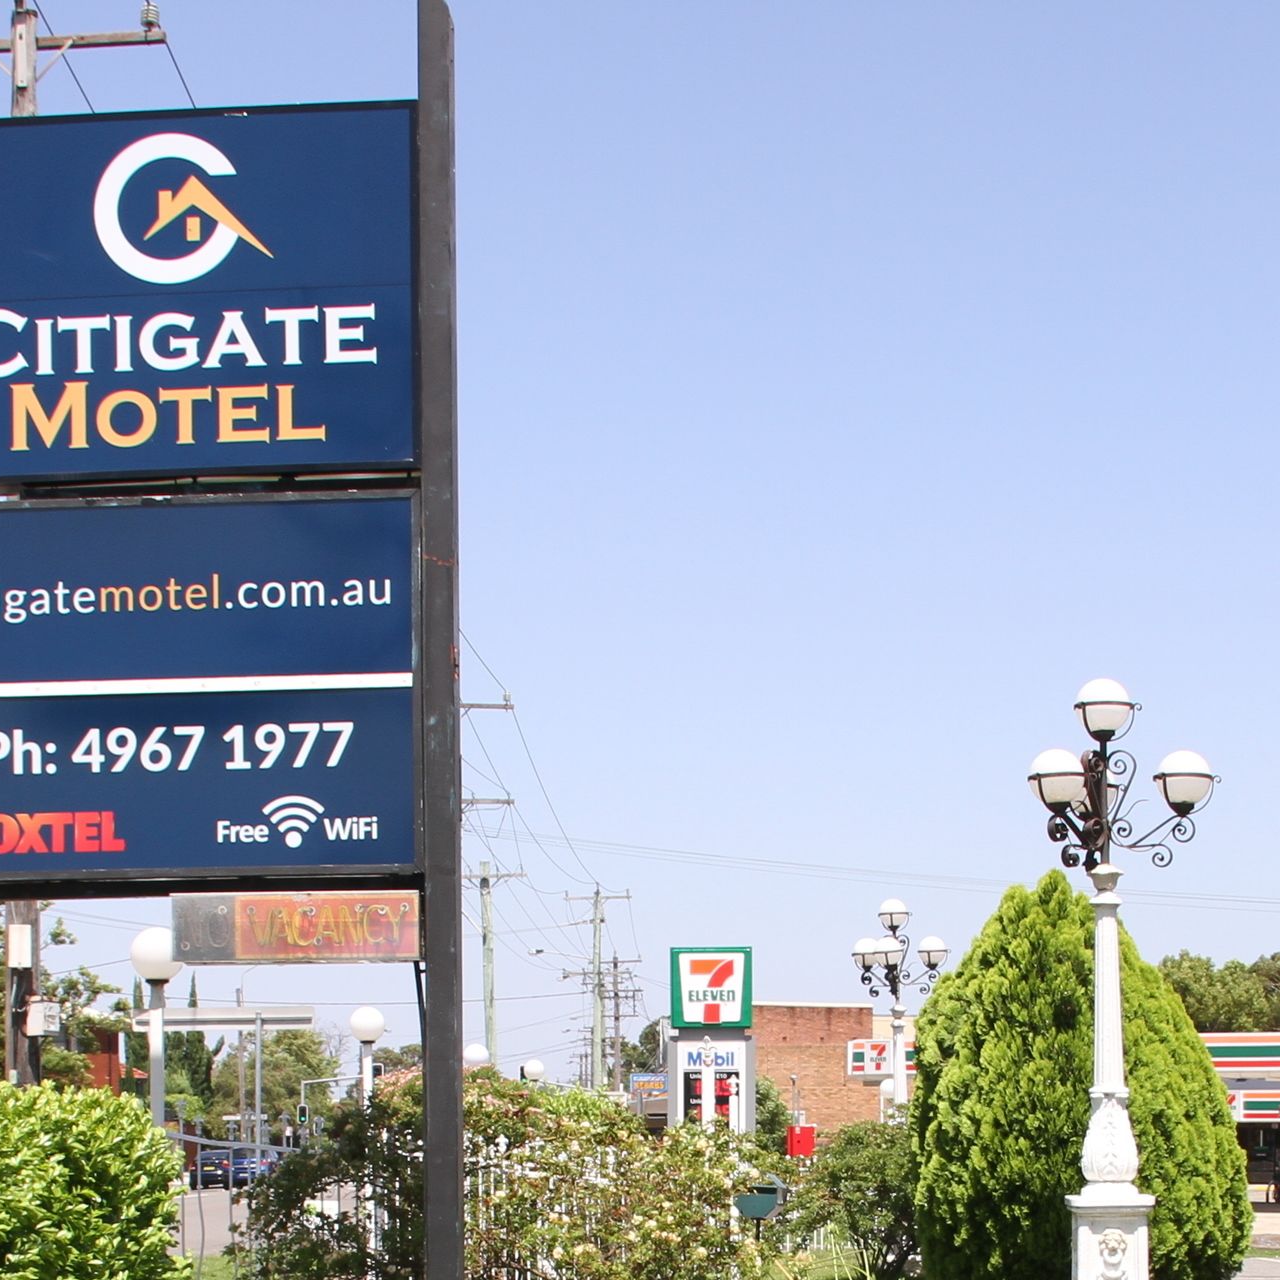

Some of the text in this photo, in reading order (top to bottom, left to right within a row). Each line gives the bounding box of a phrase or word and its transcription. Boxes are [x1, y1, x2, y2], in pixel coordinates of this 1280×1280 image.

[71, 725, 205, 773] 4967
[223, 721, 354, 770] 1977
[216, 816, 379, 843] Free WiFi
[182, 903, 409, 948] NO VACANCY
[690, 959, 734, 1023] 7
[687, 1051, 735, 1067] Mbil
